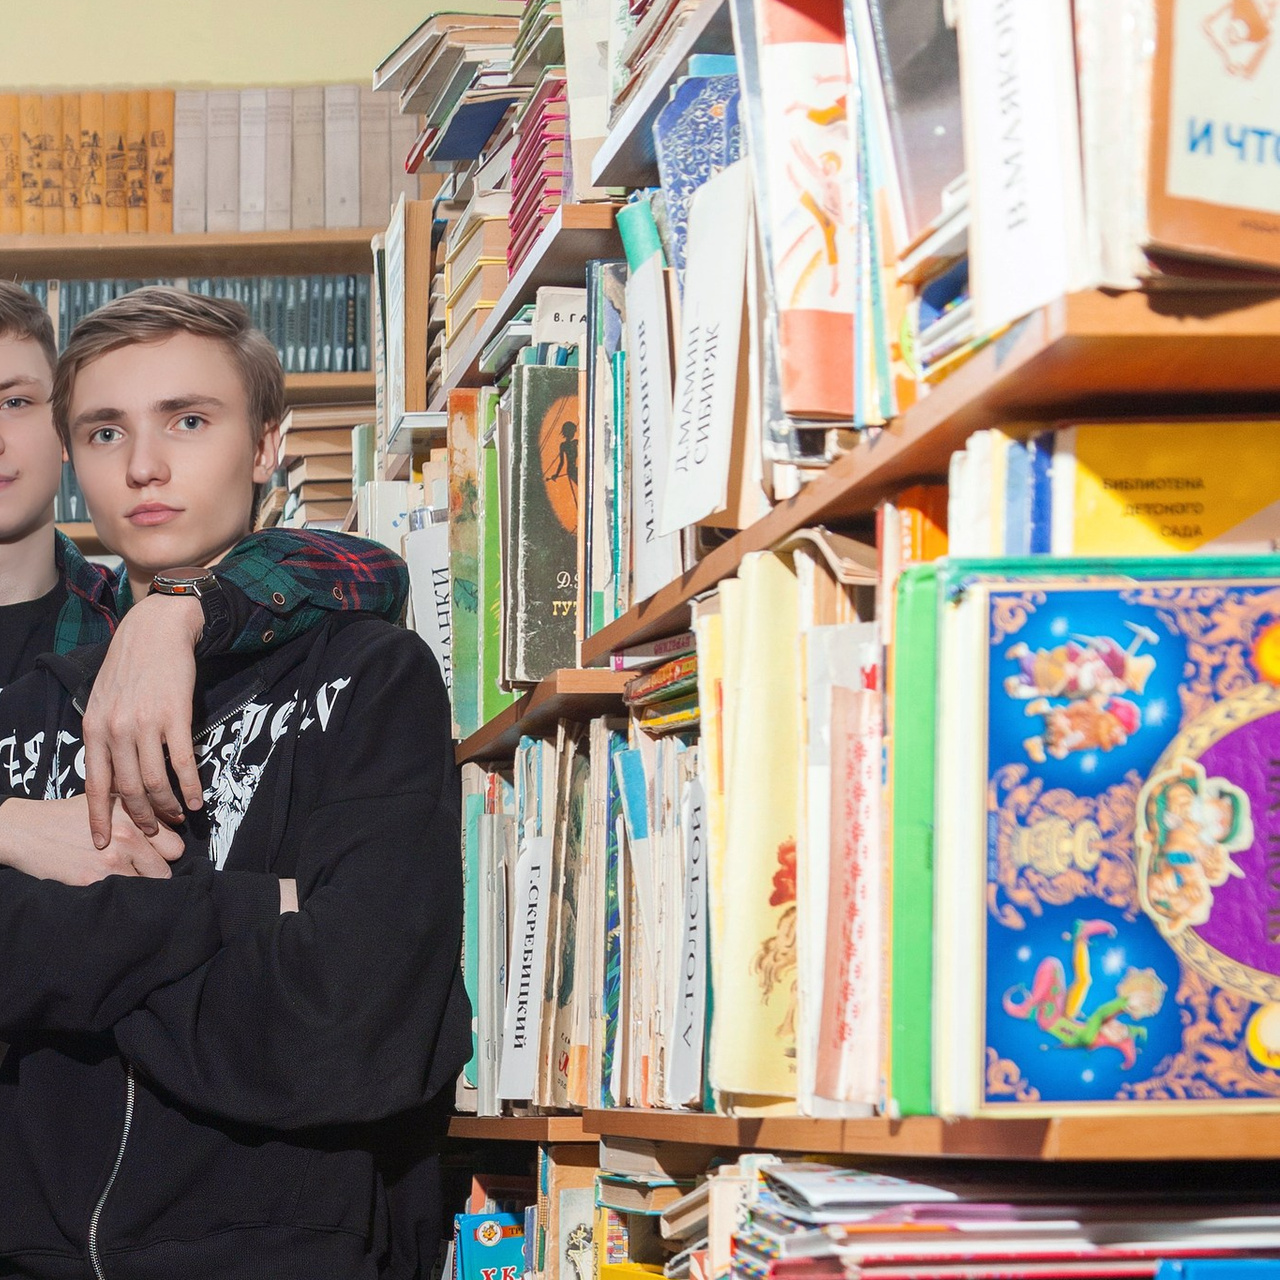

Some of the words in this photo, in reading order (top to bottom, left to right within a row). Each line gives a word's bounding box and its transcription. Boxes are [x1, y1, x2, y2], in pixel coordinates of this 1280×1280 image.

[1188, 117, 1213, 155] И
[553, 313, 565, 323] В.
[693, 322, 720, 465] СИБИРЯК
[638, 319, 656, 543] М.ЛЕРМОНТОВ
[513, 864, 541, 1050] Г.СКРЕБИЦКИЙ
[682, 805, 702, 1048] А.ТОЛСТОЙ
